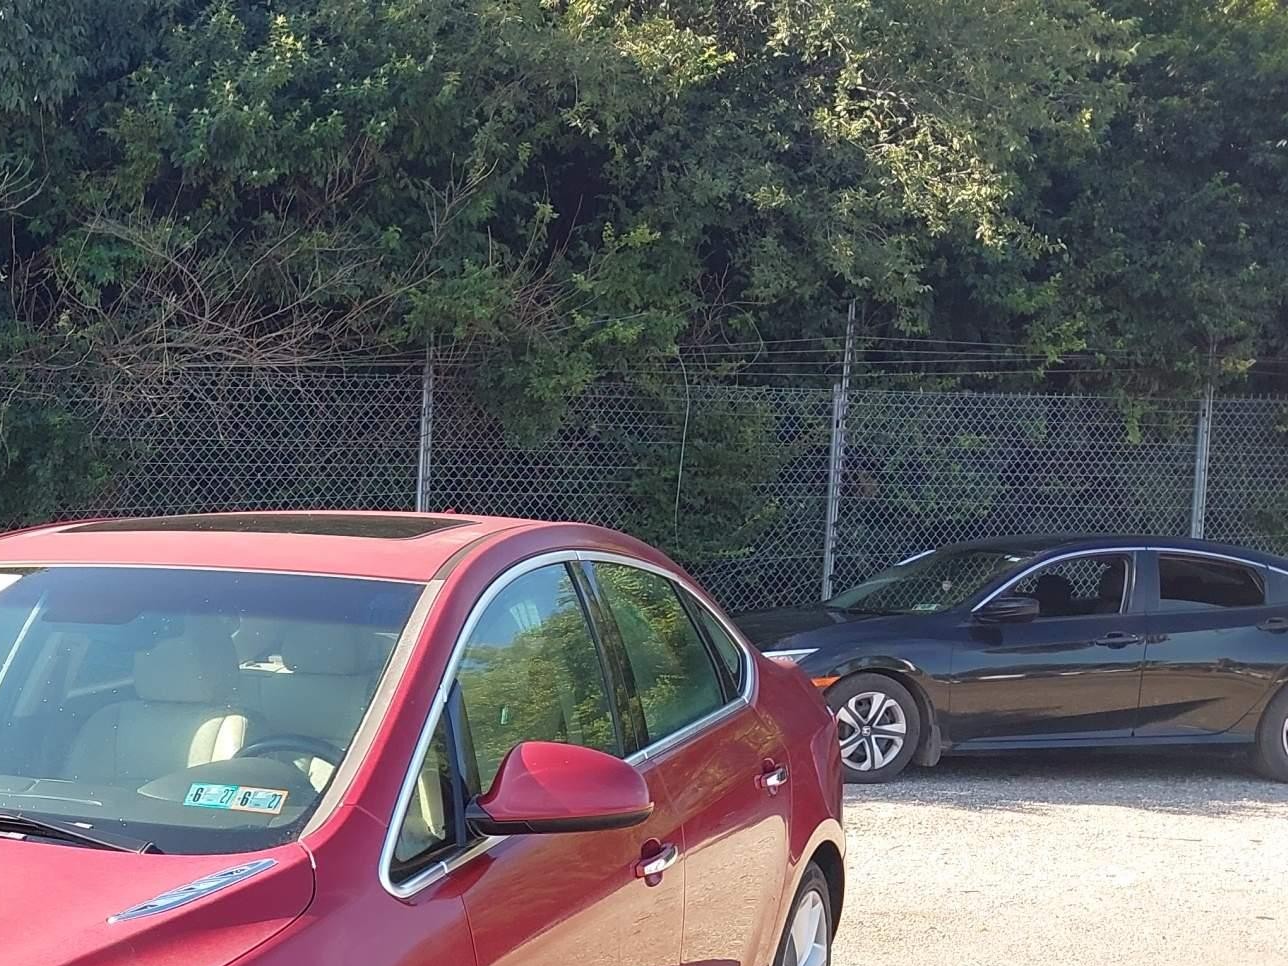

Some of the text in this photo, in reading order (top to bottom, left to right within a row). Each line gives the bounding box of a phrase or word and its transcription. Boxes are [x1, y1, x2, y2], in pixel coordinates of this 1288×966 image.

[192, 787, 235, 804] 6 27
[239, 791, 282, 809] 6 27
